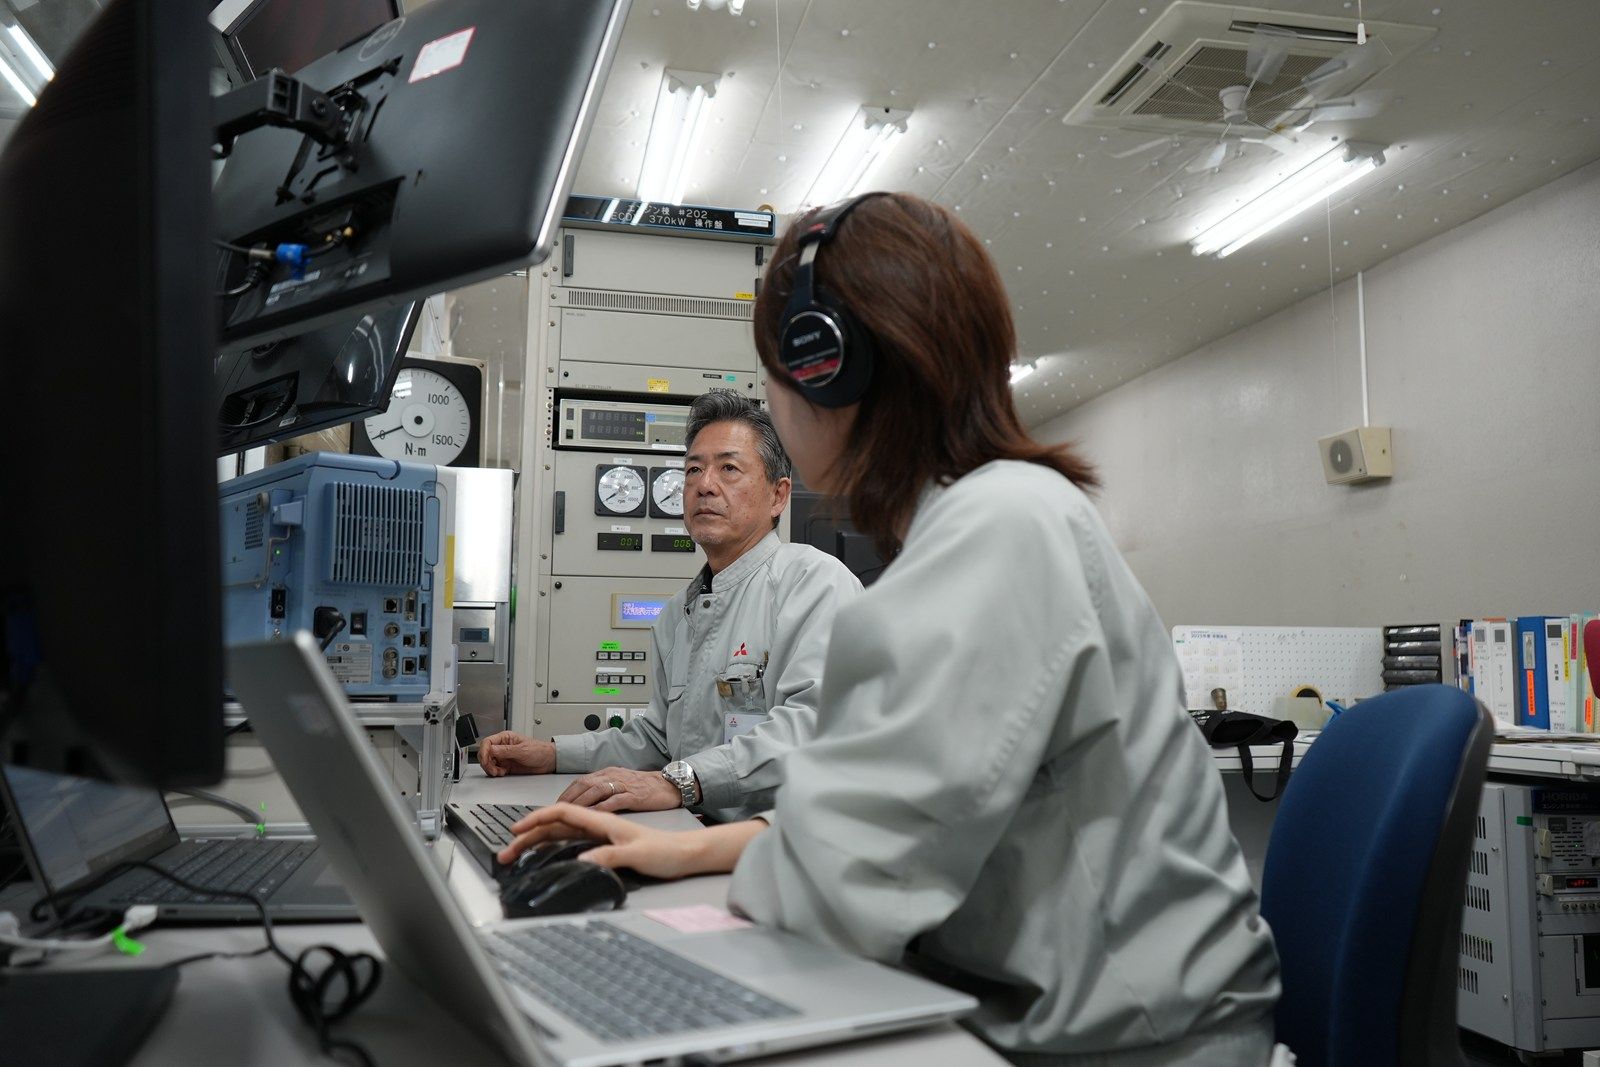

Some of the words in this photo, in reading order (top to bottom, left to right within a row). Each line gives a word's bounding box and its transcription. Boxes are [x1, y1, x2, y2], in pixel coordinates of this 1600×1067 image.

[678, 209, 708, 219] #202
[650, 215, 686, 226] 370kW
[695, 218, 723, 230] 操作盤
[792, 331, 821, 347] SONY
[428, 393, 450, 405] 1000
[432, 435, 453, 446] 1500
[673, 539, 691, 548] 006
